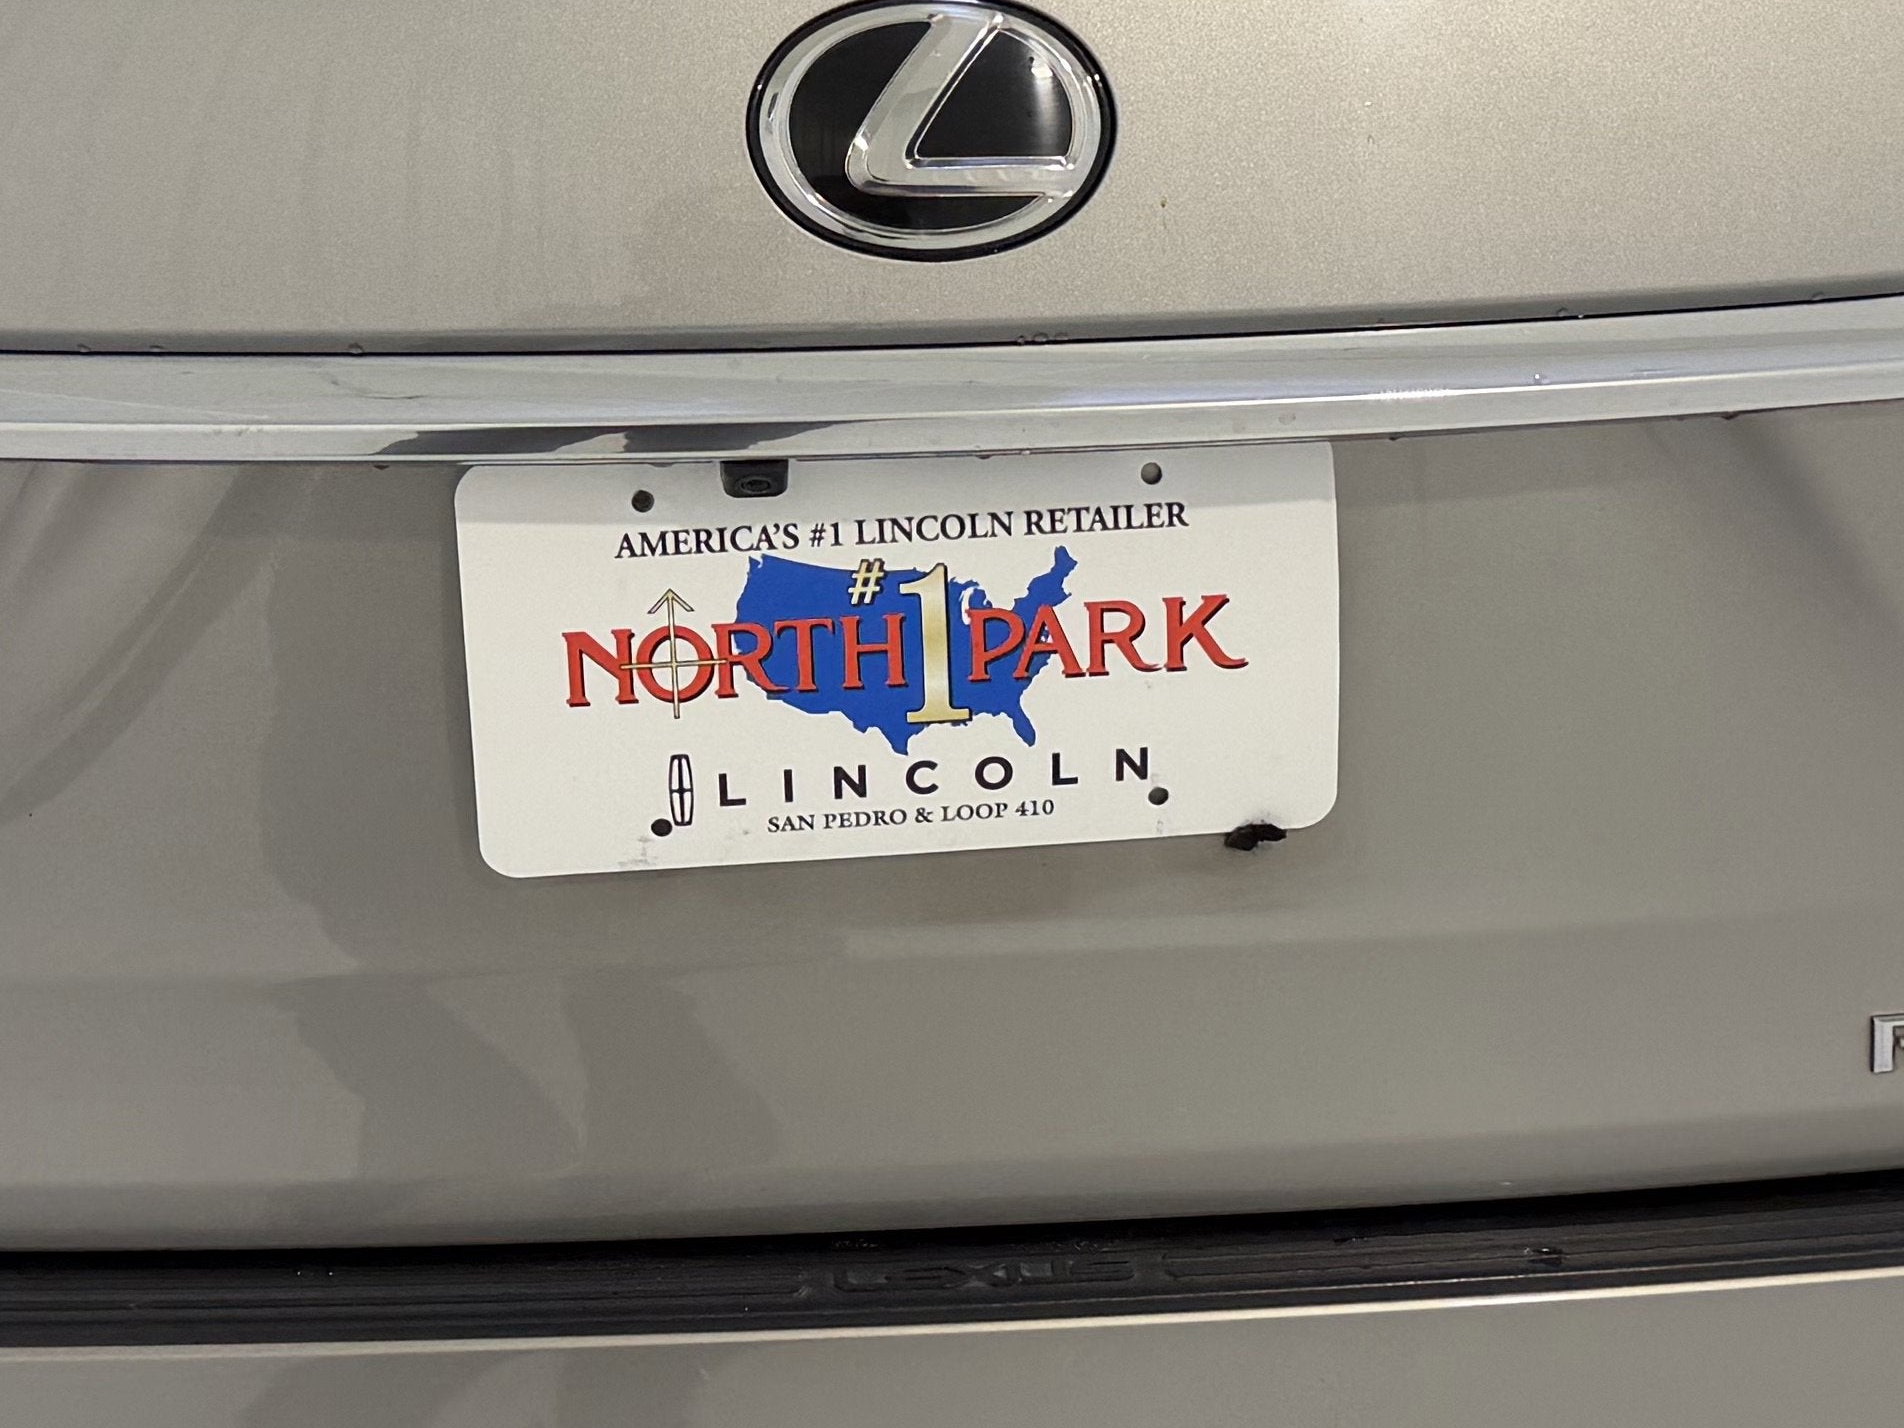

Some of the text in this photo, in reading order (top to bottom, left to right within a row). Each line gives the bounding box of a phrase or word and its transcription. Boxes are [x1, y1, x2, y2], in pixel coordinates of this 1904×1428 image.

[614, 501, 1190, 559] AMERICA'S #1 LINCOLN RETAILER
[561, 593, 1250, 708] NORTH PARK
[718, 746, 1149, 807] LINCOLN
[767, 798, 1055, 834] SAN PEDRO & LOOP 410
